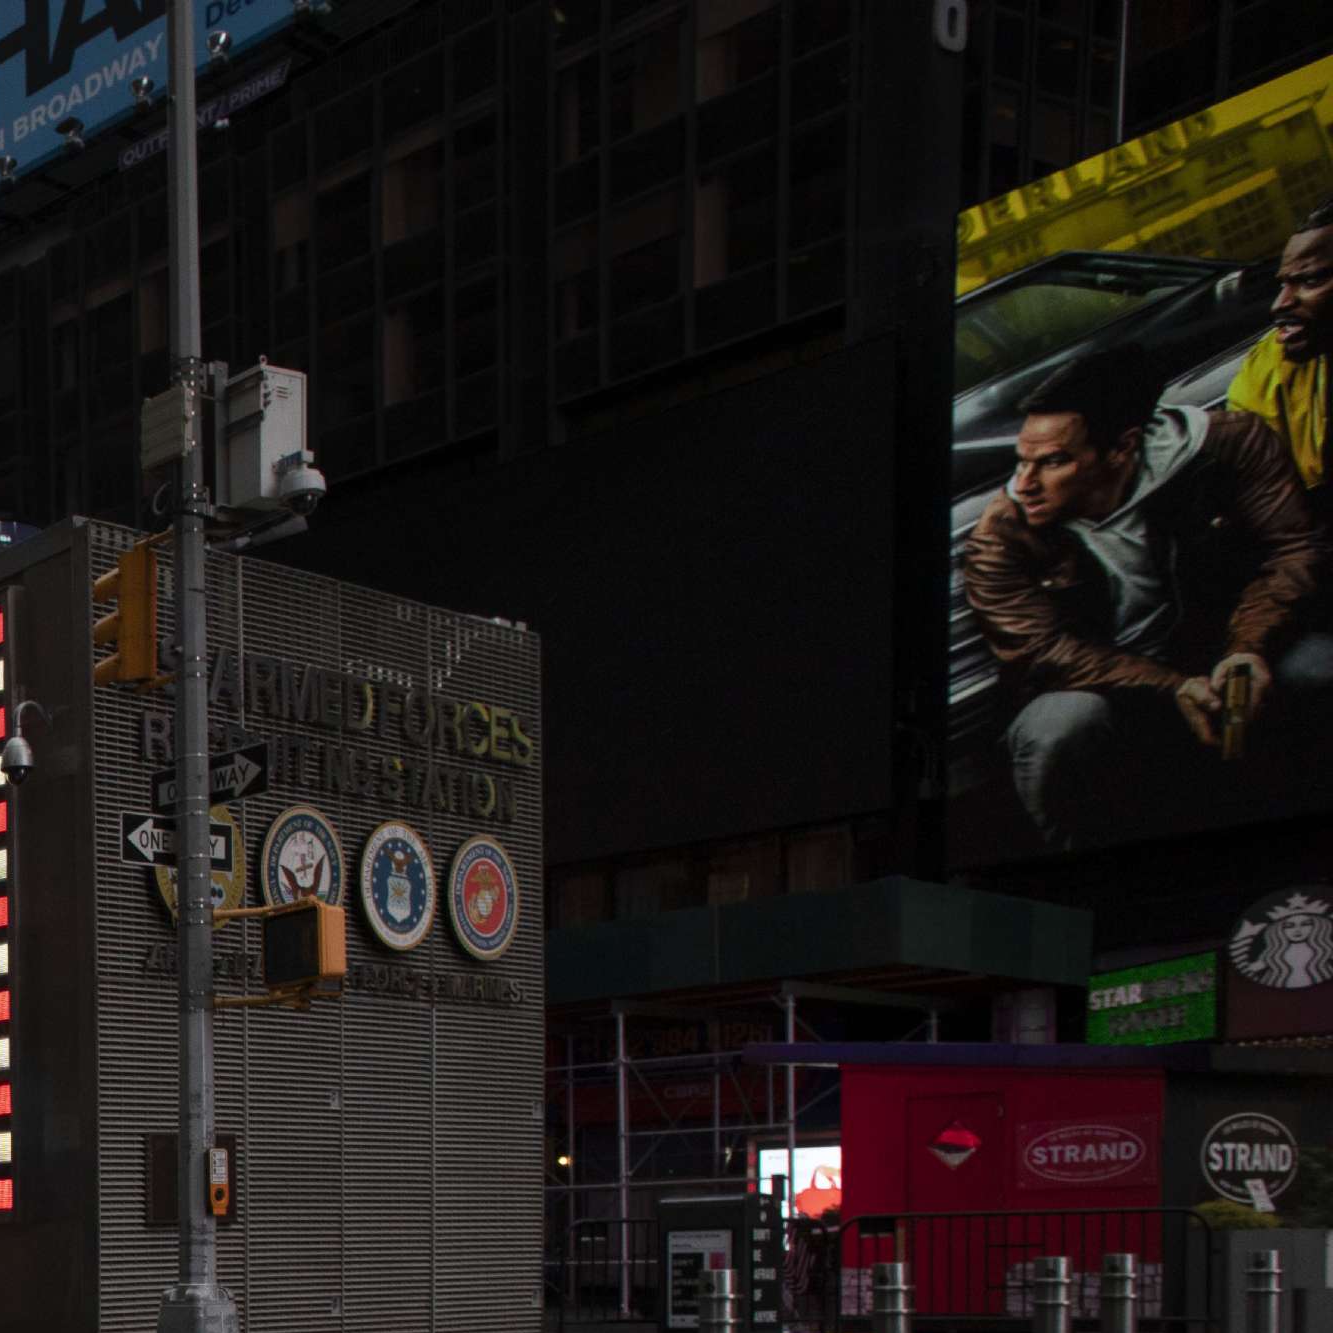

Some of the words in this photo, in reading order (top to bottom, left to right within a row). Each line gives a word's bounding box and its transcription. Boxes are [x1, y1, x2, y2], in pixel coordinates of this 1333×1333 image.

[13, 31, 166, 144] BROADWAY
[209, 648, 374, 731] ARMED
[377, 682, 535, 767] FORCES
[215, 763, 250, 788] WAY
[382, 755, 518, 820] STATION
[139, 830, 170, 849] ONE
[1032, 1140, 1138, 1165] STRAND
[1208, 1141, 1292, 1172] STRAND
